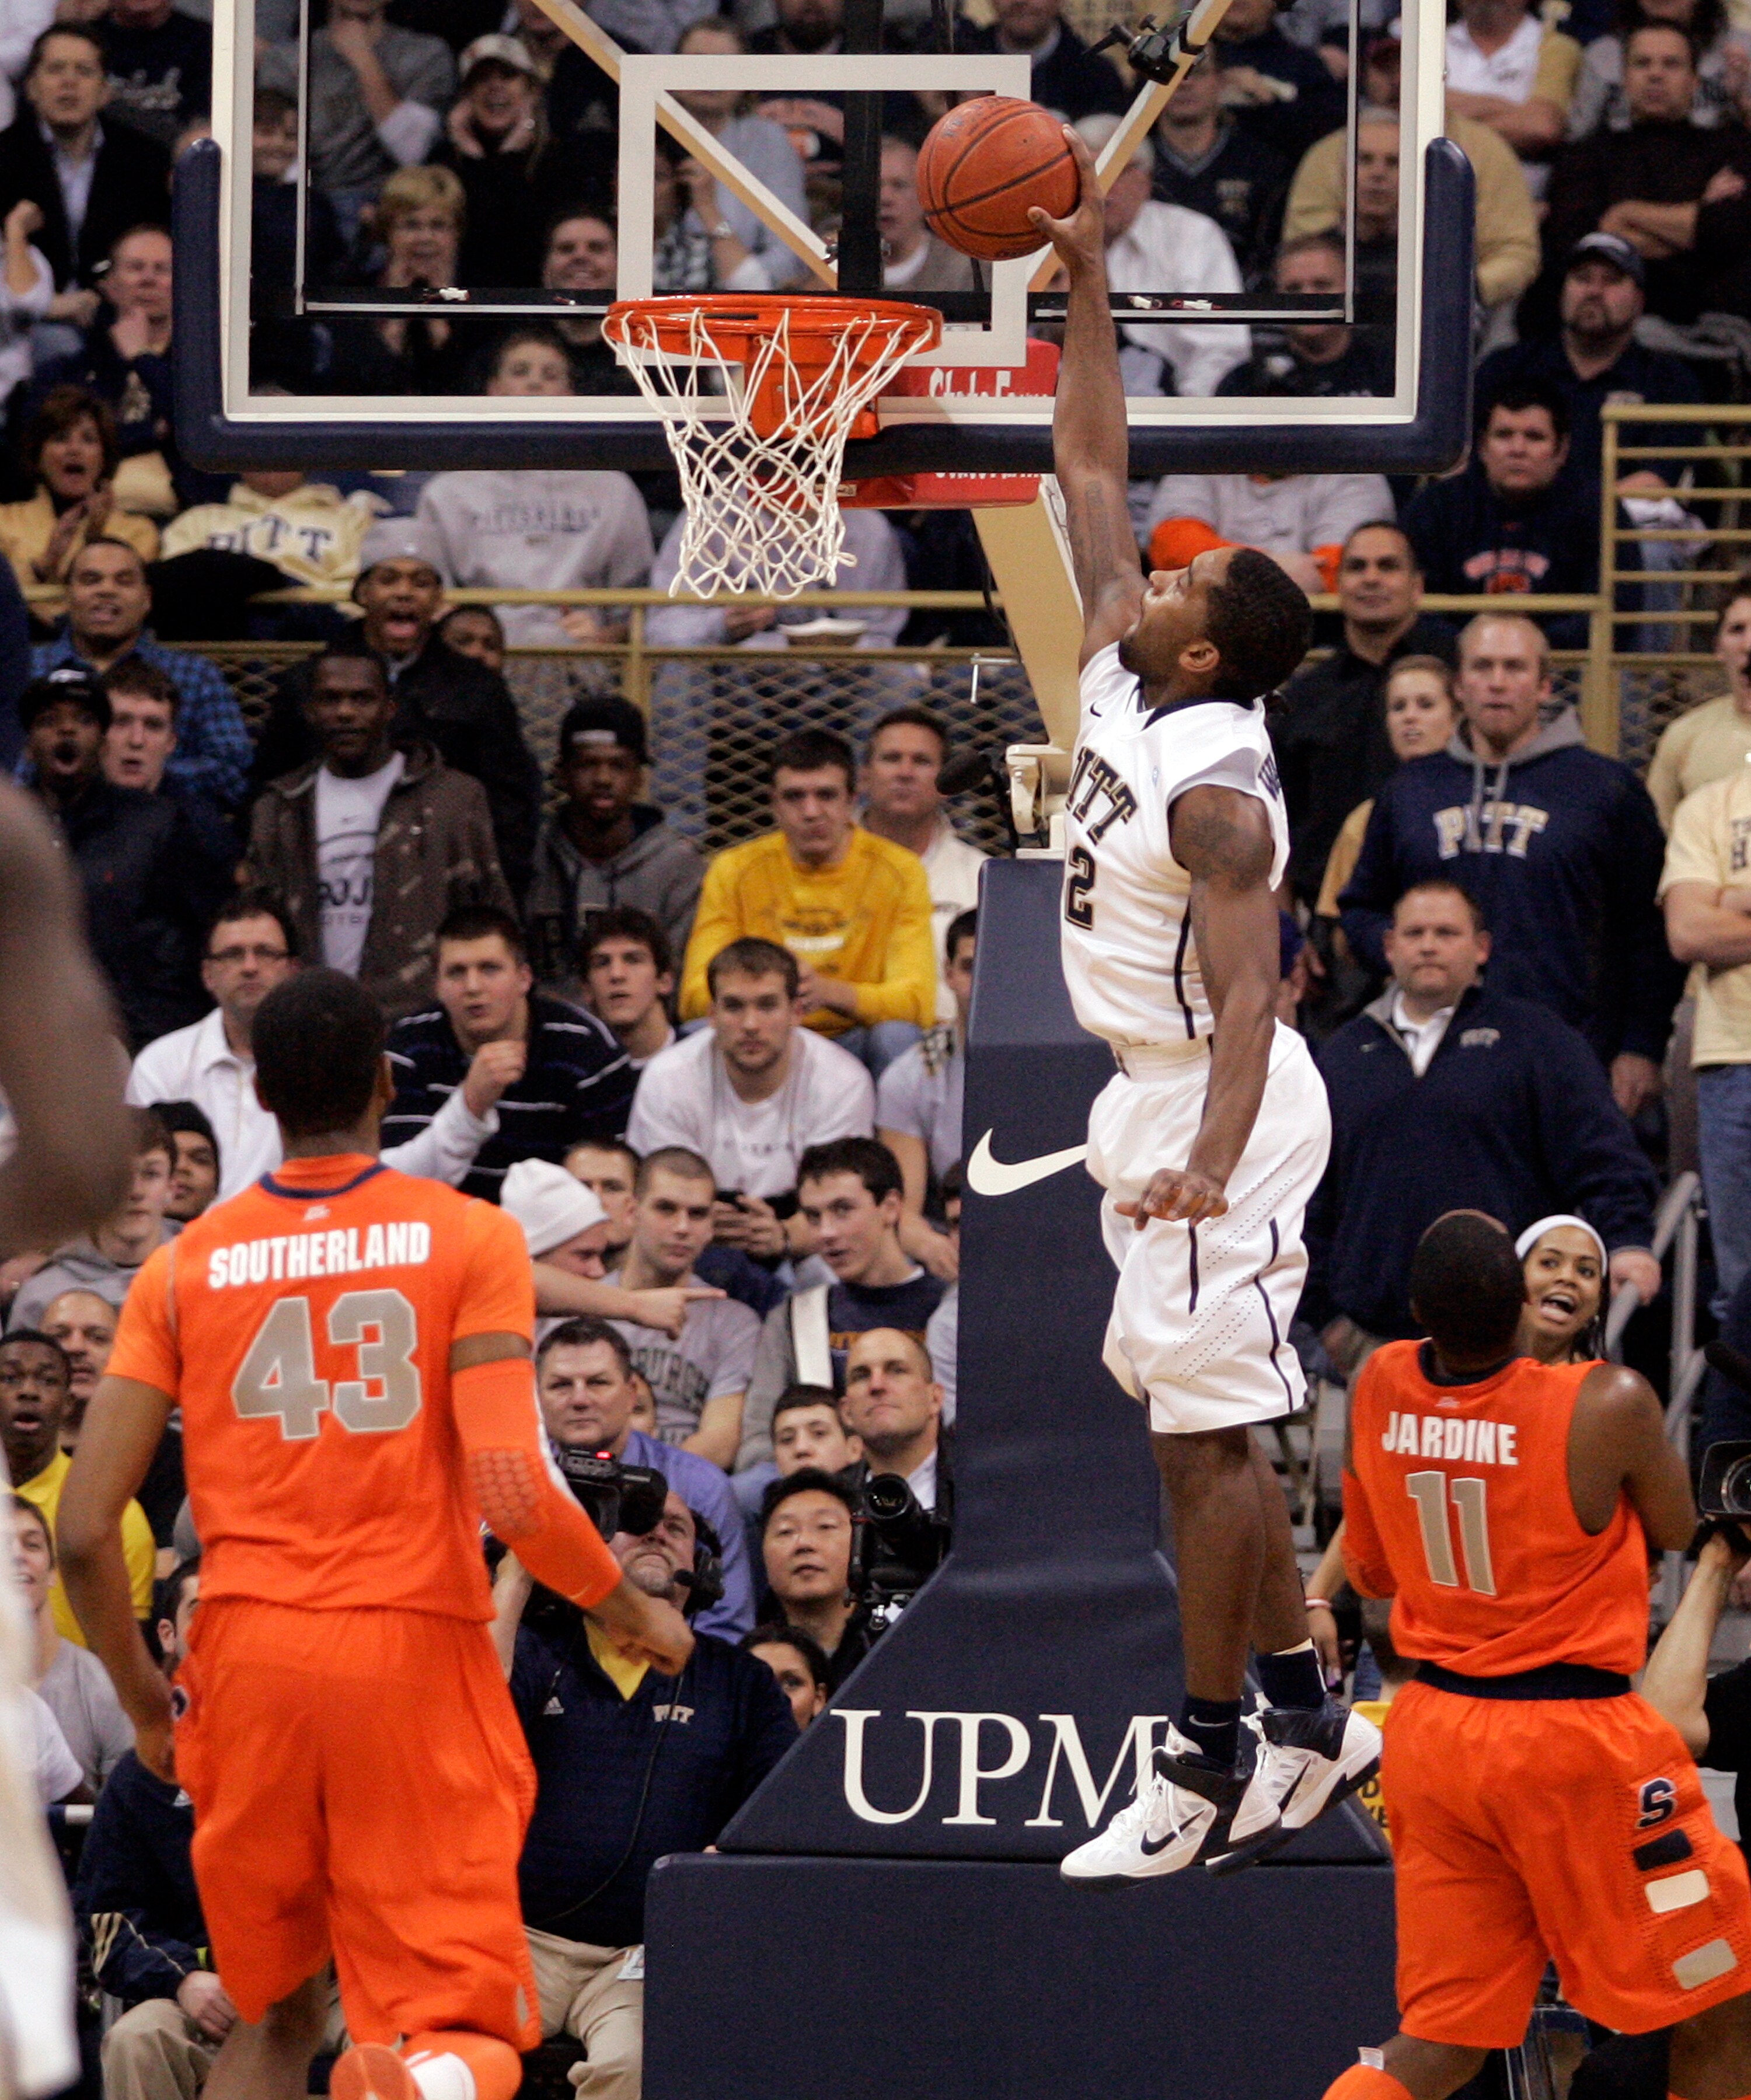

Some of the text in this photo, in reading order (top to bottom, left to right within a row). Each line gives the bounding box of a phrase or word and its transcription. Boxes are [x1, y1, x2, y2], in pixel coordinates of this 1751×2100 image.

[1432, 801, 1550, 861] PITT
[208, 1222, 432, 1289] SOUTHERLAND
[231, 1288, 423, 1442] 43
[1381, 1410, 1520, 1466] JARDINE
[1405, 1470, 1497, 1597] 11
[830, 1708, 1169, 1829] UPM
[1636, 1776, 1677, 1829] S
